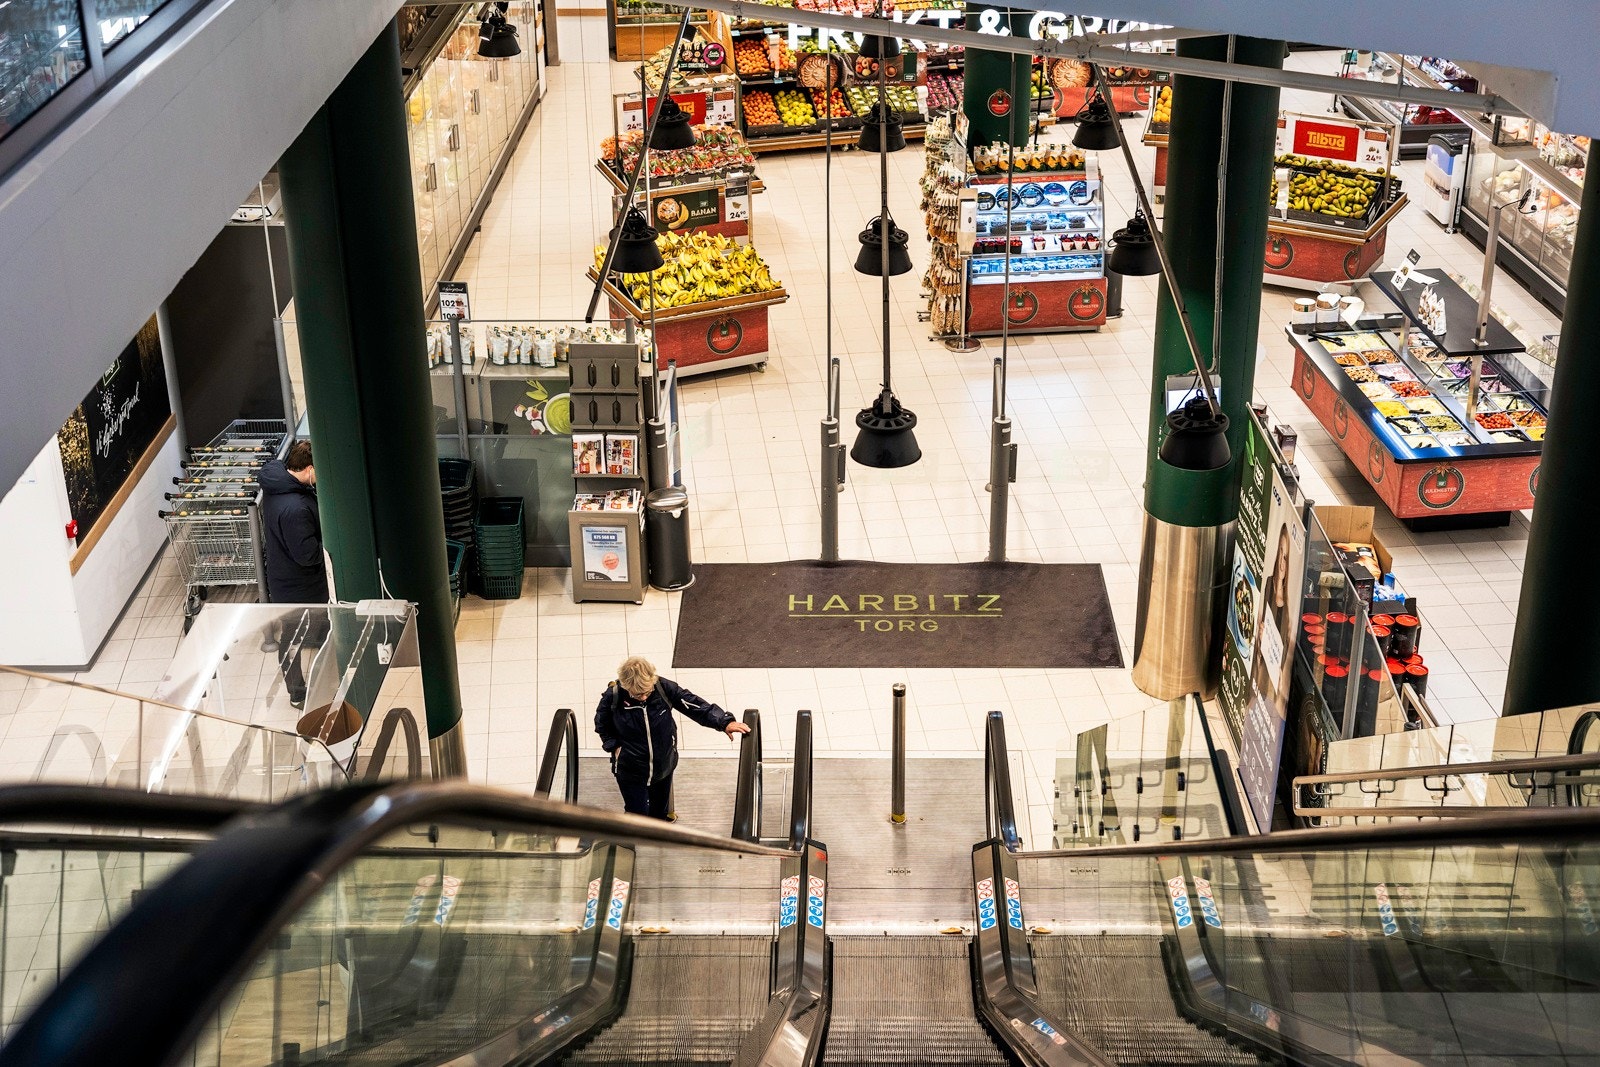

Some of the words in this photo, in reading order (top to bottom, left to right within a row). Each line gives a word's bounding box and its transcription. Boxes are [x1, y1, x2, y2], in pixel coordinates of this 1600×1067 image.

[977, 9, 1011, 36] &
[1306, 131, 1345, 149] Tilbud
[691, 207, 717, 217] BANAN
[788, 594, 1002, 612] HARBITZ
[854, 619, 939, 632] TORG
